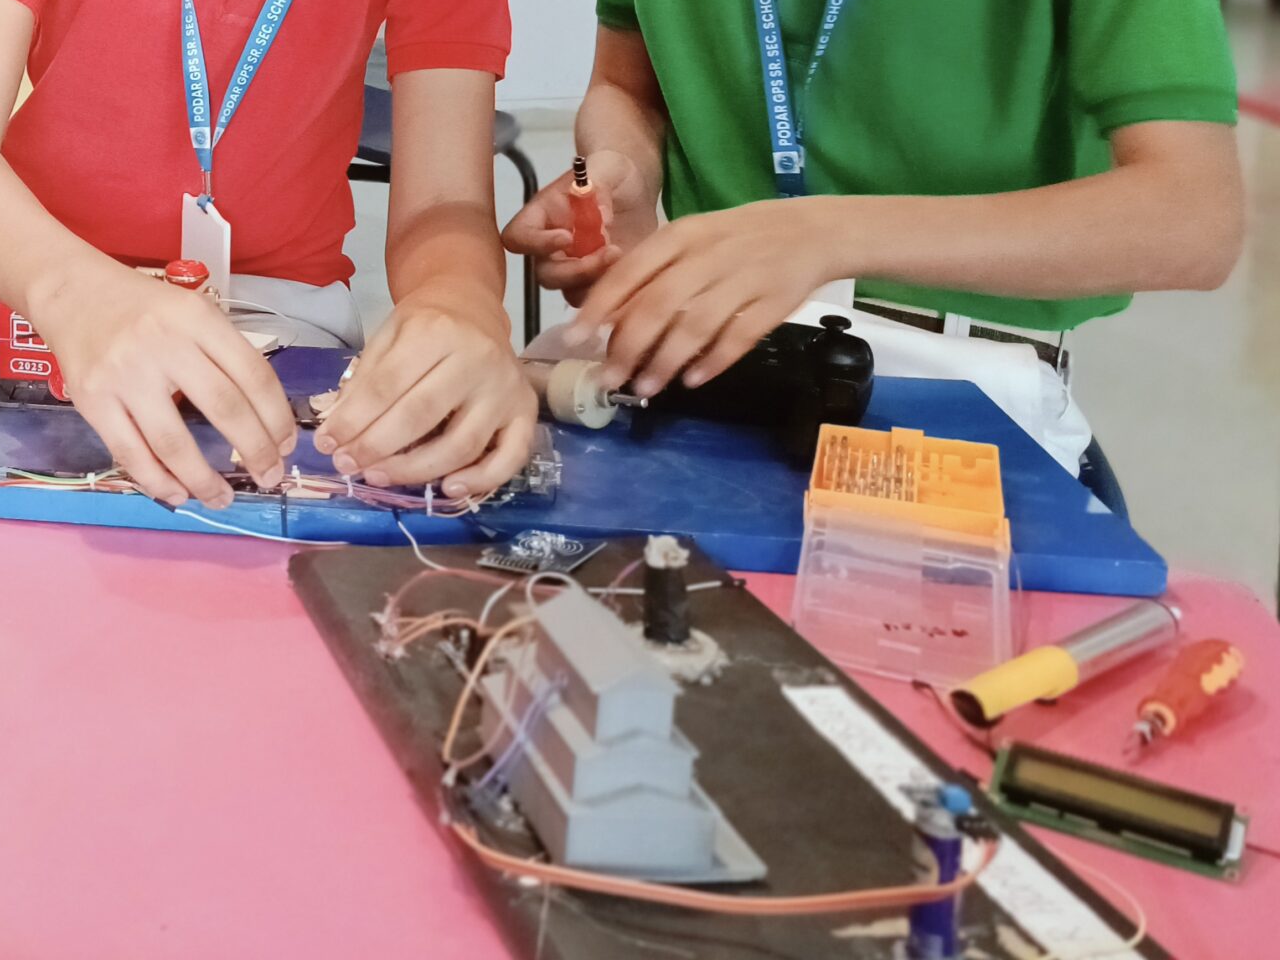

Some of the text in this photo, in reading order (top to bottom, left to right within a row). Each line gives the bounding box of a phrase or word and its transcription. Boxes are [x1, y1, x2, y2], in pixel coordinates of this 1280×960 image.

[187, 38, 198, 57] SR.
[766, 31, 779, 57] SEC.
[189, 56, 201, 81] GPS
[221, 85, 243, 123] PODAR
[237, 61, 254, 87] GPS
[248, 46, 264, 64] SR.
[256, 21, 275, 46] SEC.
[769, 57, 783, 78] SR.
[192, 81, 206, 122] PODAR
[771, 78, 785, 102] GPS
[774, 102, 793, 147] PODAR
[18, 361, 44, 372] 2025
